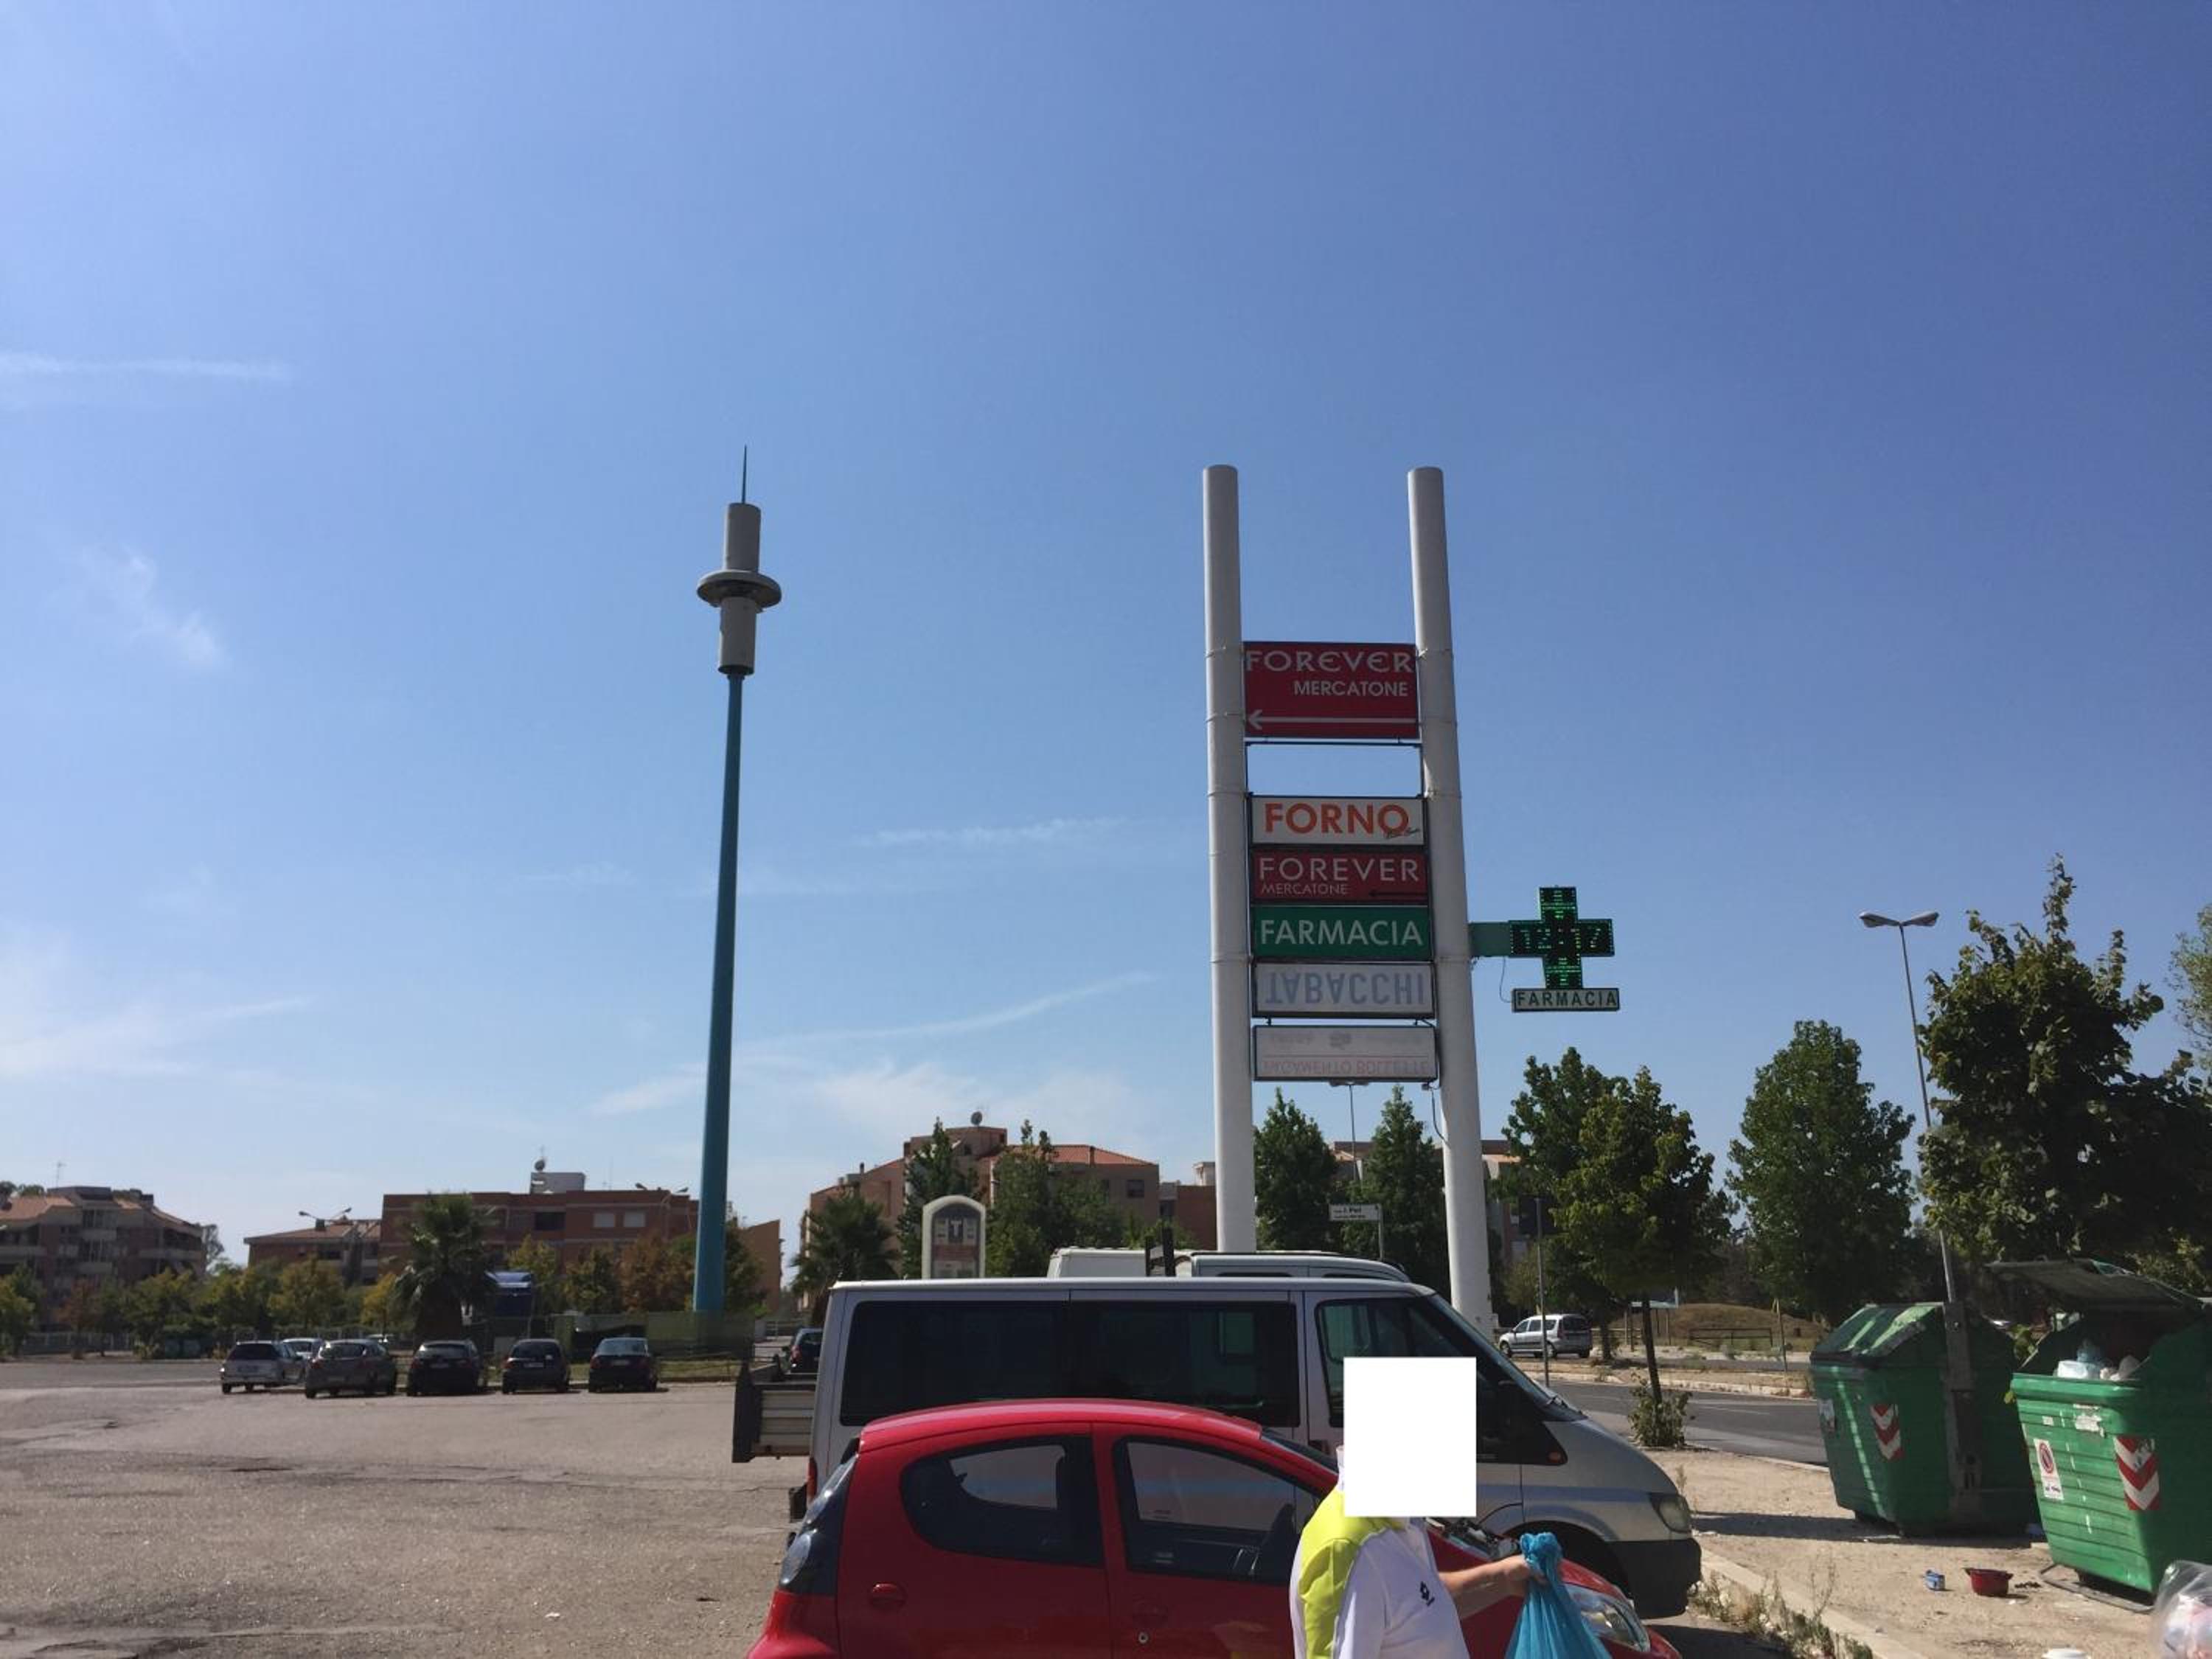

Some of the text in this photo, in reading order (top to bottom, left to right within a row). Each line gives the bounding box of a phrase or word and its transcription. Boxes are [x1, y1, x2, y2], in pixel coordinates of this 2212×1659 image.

[1245, 650, 1413, 672] FOREVER
[1294, 680, 1408, 697] MERCATONE
[1265, 802, 1409, 834] FORNO
[1259, 858, 1419, 882] FOREVER
[1262, 884, 1349, 895] MERCATONE
[1261, 919, 1423, 945] FARMACIA
[1517, 992, 1617, 1006] FARMACIA
